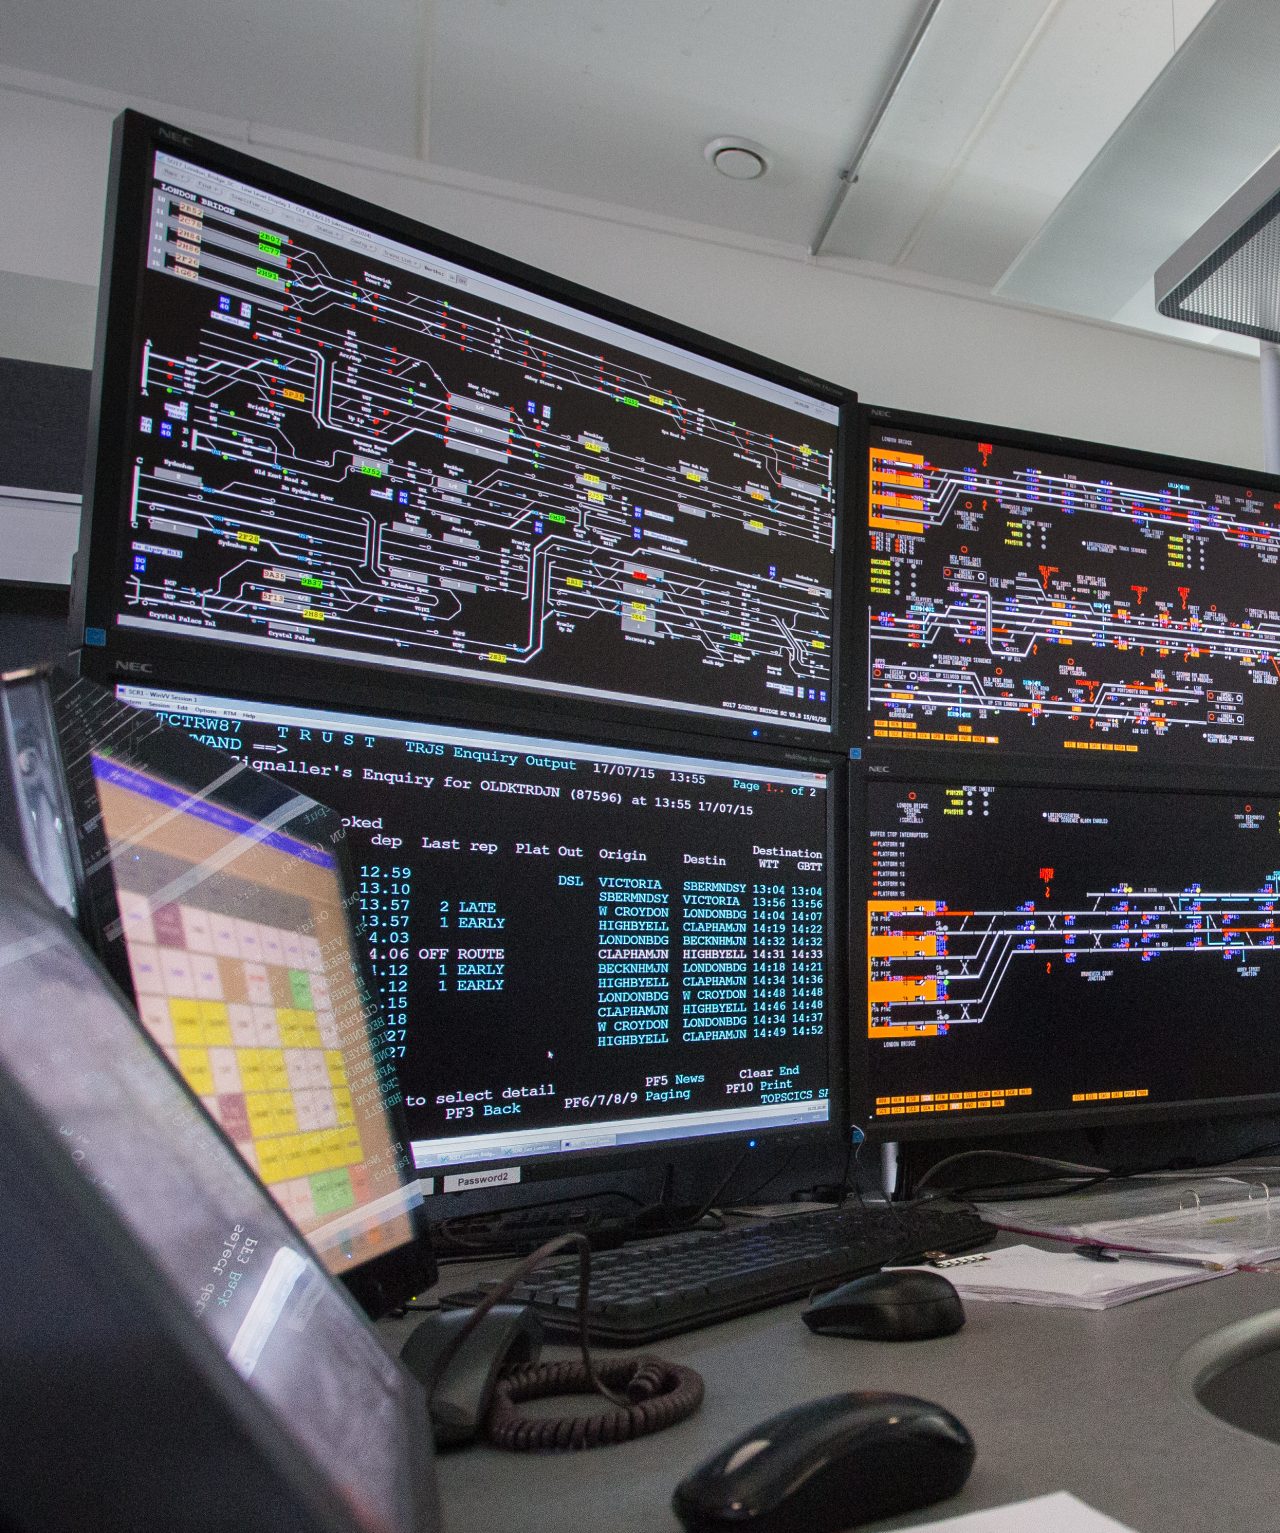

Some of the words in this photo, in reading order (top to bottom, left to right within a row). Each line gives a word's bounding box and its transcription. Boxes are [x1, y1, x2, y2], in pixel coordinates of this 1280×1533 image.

[161, 183, 197, 201] LONDON
[200, 197, 236, 215] BRIDGE
[302, 578, 322, 588] 9B37
[304, 609, 324, 619] 2H89
[116, 660, 152, 673] NEC
[156, 712, 241, 733] TCTRW87
[278, 726, 289, 738] T
[300, 729, 312, 741] R
[322, 732, 333, 743] U
[344, 734, 354, 745] S
[365, 737, 375, 748] T
[406, 741, 444, 755] TRJS
[453, 747, 519, 766] Enquiry
[526, 756, 576, 771] Output
[593, 763, 655, 779] 17/07/15
[670, 772, 705, 784] 13:55
[733, 779, 760, 792] Page
[791, 787, 804, 795] of
[810, 788, 816, 797] 2
[363, 768, 434, 788] Enquiry
[444, 777, 471, 789] for
[481, 780, 560, 797] OLDKTRDJN
[571, 789, 621, 804] (87596)
[632, 796, 647, 805] at
[655, 797, 691, 809] 13:55
[699, 802, 753, 815] 17/07/15
[371, 834, 402, 849] dep
[422, 837, 460, 850] Last
[470, 843, 498, 854] rep
[516, 843, 550, 855] Plat
[558, 846, 583, 857] Out
[599, 849, 646, 862] Origin
[684, 854, 726, 865] Destin
[753, 846, 822, 859] Destination
[759, 859, 779, 869] WTT
[797, 861, 822, 871] GBTT
[361, 866, 411, 878] 12.59
[558, 876, 583, 886] DSL
[598, 877, 662, 889] VICTORIA
[684, 881, 746, 893] SBERMNDSY
[753, 885, 785, 894] 13:04
[792, 886, 822, 896] 13:04
[360, 882, 410, 894] 13.10
[599, 892, 669, 903] SBERMNDSY
[683, 895, 740, 906] VICTORIA
[753, 897, 785, 907] 13:56
[792, 899, 822, 908] 13:56
[360, 899, 409, 910] 13.57
[440, 901, 448, 912] 2
[459, 902, 496, 913] LATE
[599, 906, 607, 915] W
[615, 907, 669, 917] CROYDON
[683, 909, 747, 919] LONDONBDG
[753, 911, 785, 920] 14:04
[792, 912, 822, 921] 14:07
[440, 917, 448, 927] 1
[458, 917, 505, 928] EARLY
[599, 920, 669, 931] HIGHBYELL
[683, 922, 746, 932] CLAPHAMJN
[753, 924, 785, 933] 14:19
[792, 924, 822, 933] 14:22
[368, 932, 409, 943] 4.03
[599, 935, 669, 945] LONDONBDG
[683, 936, 746, 945] BECKNHMJN
[753, 936, 785, 945] 14:32
[792, 937, 822, 946] 14:32
[370, 948, 409, 959] 4.06
[419, 949, 449, 959] OFF
[458, 949, 504, 959] ROUTE
[598, 949, 669, 959] CLAPHAMJN
[683, 949, 747, 959] HIGHBYELL
[753, 950, 785, 959] 14:31
[792, 950, 823, 958] 14:33
[440, 965, 447, 975] 1
[457, 964, 504, 975] EARLY
[598, 963, 669, 973] BECKNHMJN
[683, 963, 746, 972] LONDONBDG
[753, 962, 785, 972] 14:18
[792, 962, 822, 971] 14:21
[439, 980, 447, 991] 1
[457, 980, 504, 991] EARLY
[598, 978, 669, 988] HIGHBYELL
[683, 976, 746, 986] CLAPHAMJN
[753, 975, 785, 985] 14:34
[792, 975, 823, 984] 14:36
[598, 991, 669, 1002] LONDONBDG
[682, 991, 691, 1000] W
[697, 990, 746, 999] CROYDON
[754, 988, 785, 998] 14:48
[793, 988, 823, 997] 14:48
[598, 1005, 668, 1017] CLAPHAMJN
[683, 1003, 747, 1014] HIGHBYELL
[753, 1001, 786, 1011] 14:46
[793, 1000, 823, 1010] 14:48
[597, 1022, 607, 1032] W
[614, 1019, 668, 1031] CROYDON
[683, 1016, 747, 1028] LONDONBDG
[754, 1014, 785, 1024] 14:34
[793, 1013, 823, 1023] 14:37
[598, 1034, 668, 1046] HIGHBYELL
[683, 1029, 747, 1041] CLAPHAMJN
[754, 1027, 786, 1038] 14:49
[793, 1025, 823, 1035] 14:52
[406, 1096, 425, 1106] to
[436, 1090, 493, 1104] select
[502, 1084, 555, 1098] detail
[646, 1075, 668, 1087] PF5
[675, 1075, 704, 1084] News
[739, 1069, 773, 1078] Clear
[779, 1065, 799, 1075] End
[446, 1106, 473, 1119] PF3
[483, 1103, 521, 1116] Back
[564, 1092, 637, 1108] PF6/7/8/9
[646, 1089, 690, 1102] Paging
[726, 1082, 753, 1093] PF10
[760, 1080, 792, 1090] Print
[761, 1090, 813, 1104] TOPSCICS
[458, 1172, 508, 1186] Password2
